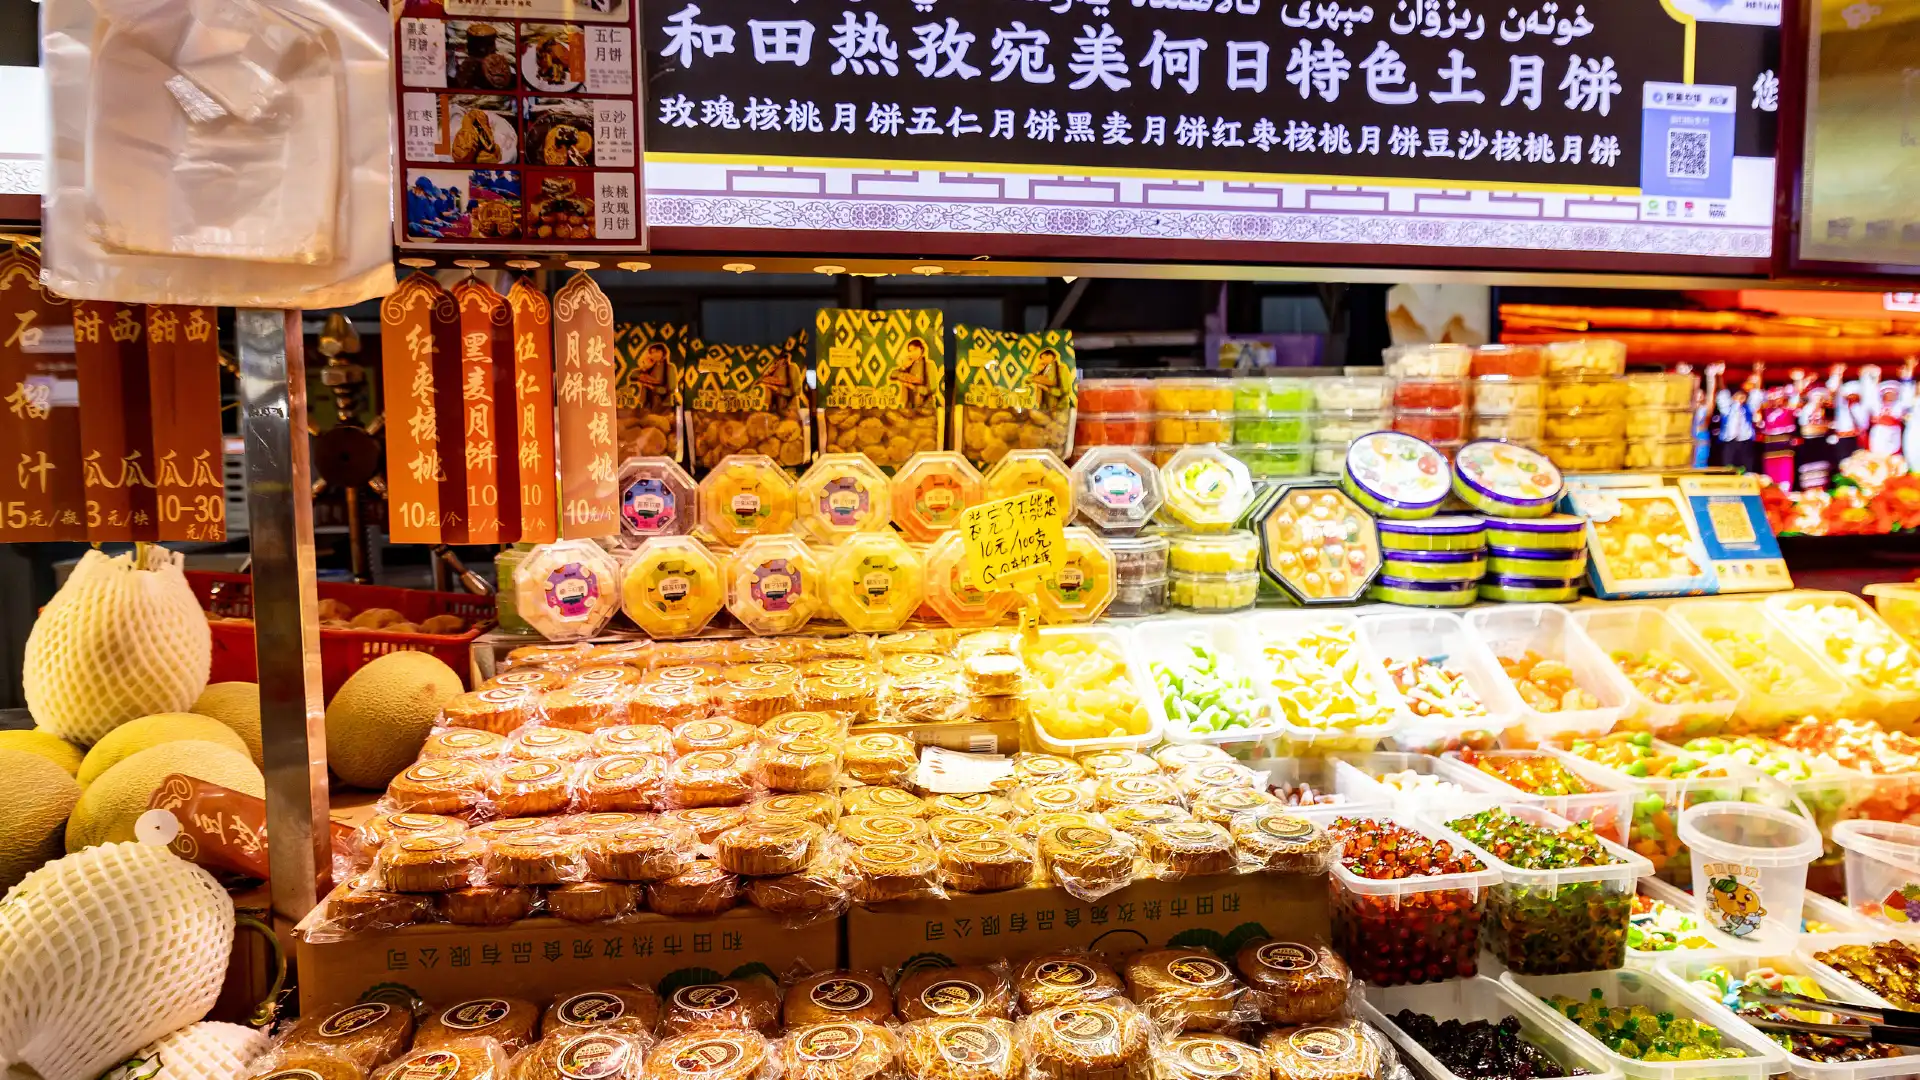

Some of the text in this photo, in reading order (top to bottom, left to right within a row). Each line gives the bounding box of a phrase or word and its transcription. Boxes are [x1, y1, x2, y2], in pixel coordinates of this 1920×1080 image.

[406, 22, 428, 36] 黑麦
[594, 29, 622, 43] 五仁
[406, 37, 428, 52] 月饼
[594, 47, 622, 63] 月饼
[660, 3, 1623, 117] 和田热孜宛美何日特色土月饼
[406, 109, 434, 123] 红枣
[599, 110, 627, 124] 豆沙
[408, 124, 434, 138] 月饼
[599, 125, 628, 140] 月饼
[658, 95, 1621, 168] 玫瑰核桃月饼五仁月饼黑麦月饼红枣核桃月饼豆沙核桃月饼
[601, 184, 629, 199] 核桃
[601, 201, 630, 215] 玫瑰
[602, 216, 631, 231] 月饼
[560, 330, 586, 409] 月饼
[405, 323, 448, 484] 红枣核桃
[461, 331, 498, 475] 黑麦月饼
[515, 331, 541, 473] 伍仁月饼
[586, 334, 617, 485] 玫瑰核桃
[467, 485, 498, 507] 10
[522, 484, 542, 506] 10
[386, 930, 744, 970] 和田市热孜宛食品有限公司
